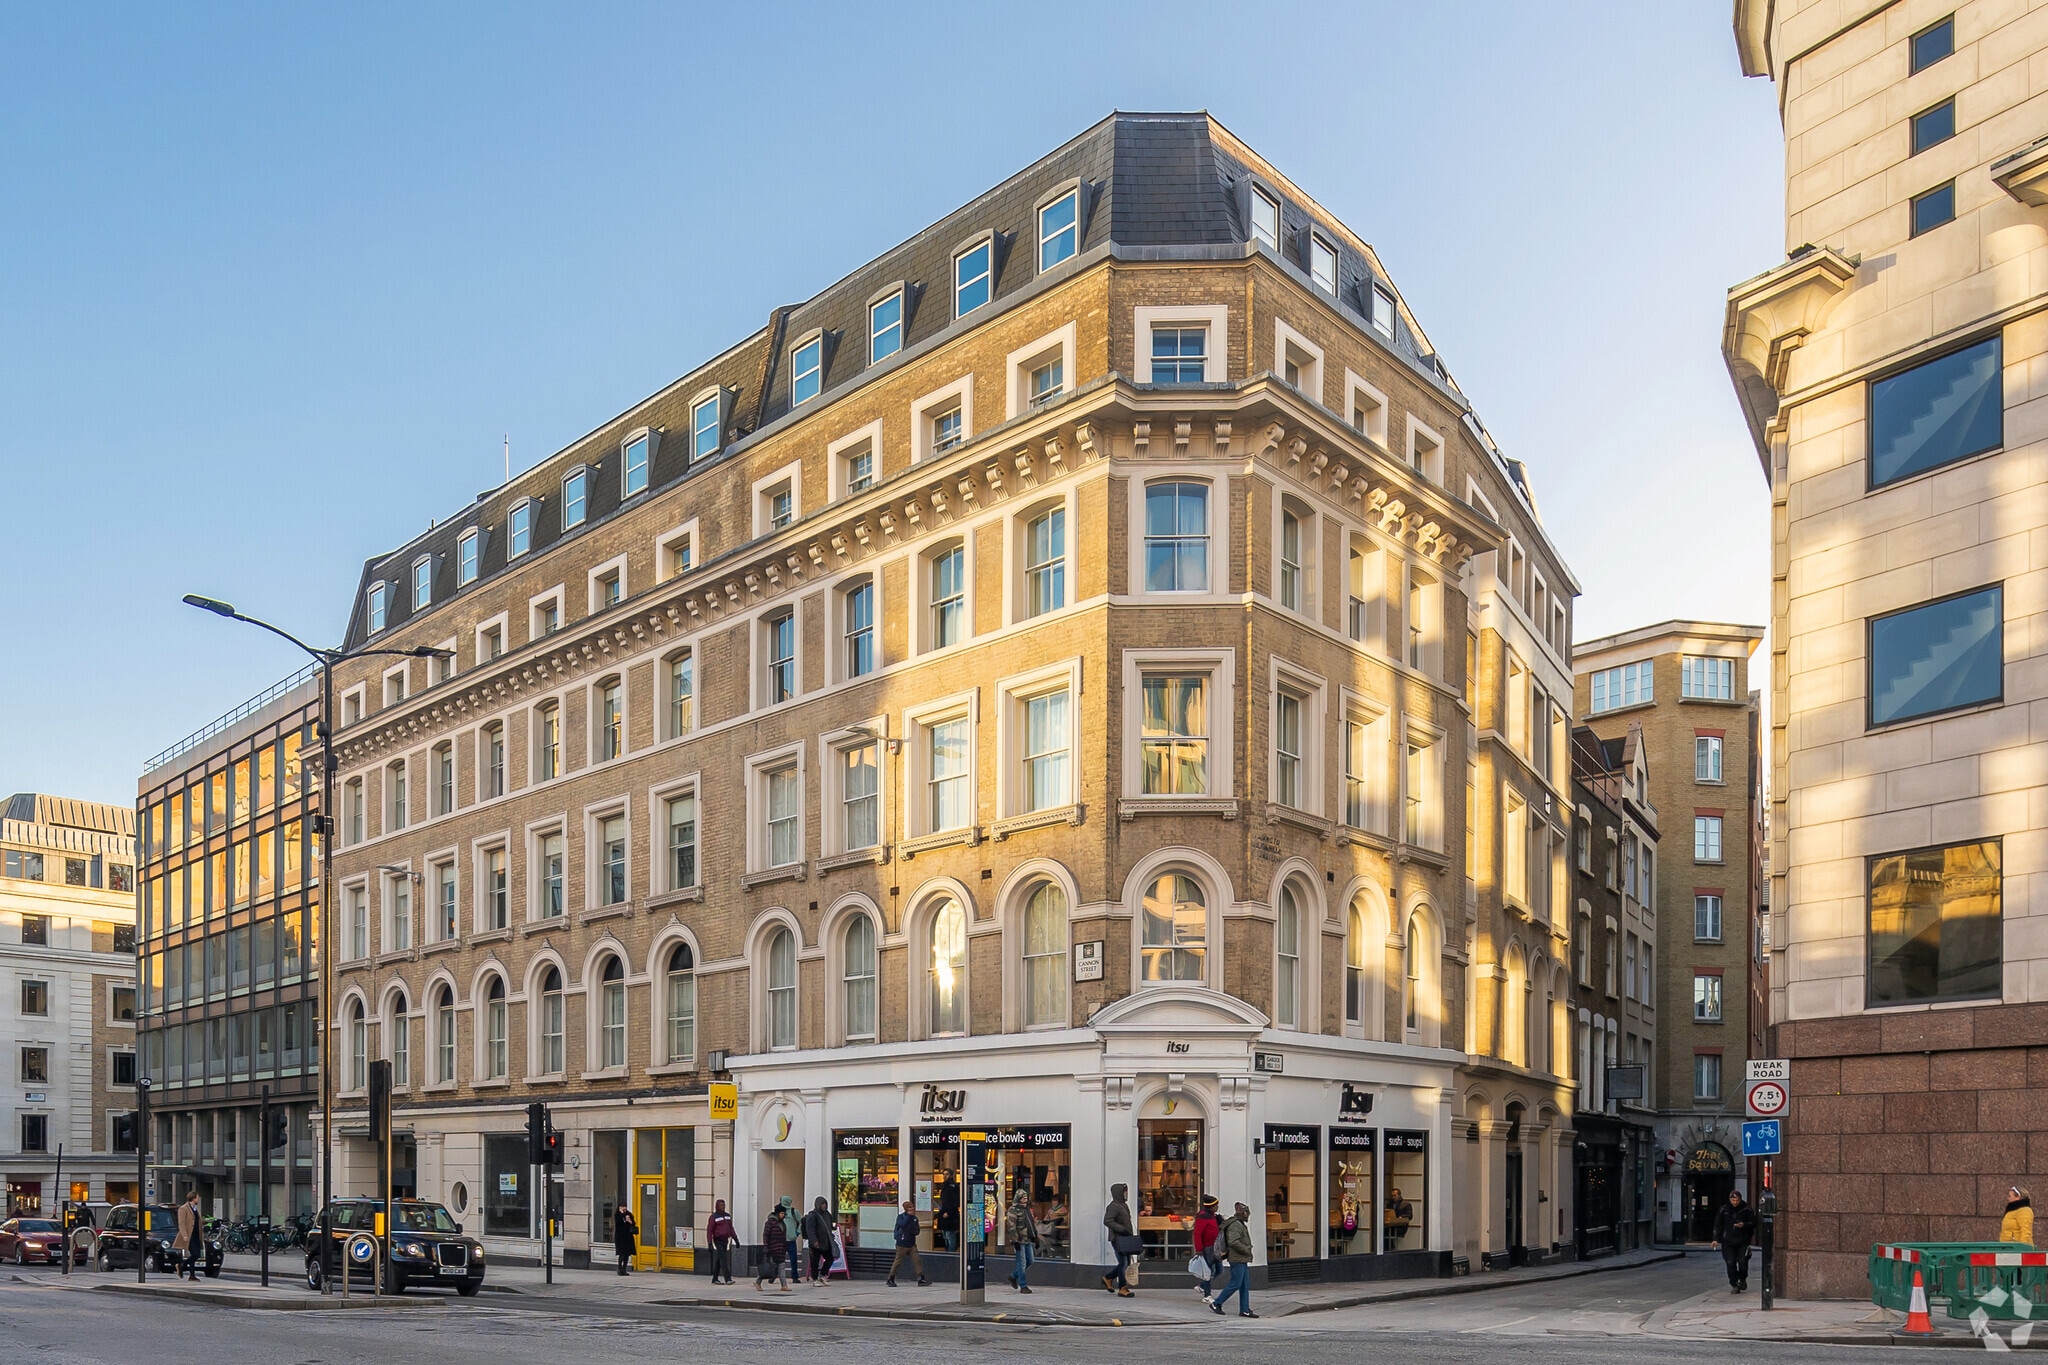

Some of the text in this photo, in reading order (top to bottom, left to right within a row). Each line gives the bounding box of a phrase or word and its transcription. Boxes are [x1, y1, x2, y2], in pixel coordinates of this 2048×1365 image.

[1166, 1040, 1190, 1053] itsu
[1753, 1070, 1783, 1078] ROAD
[713, 1095, 735, 1109] itsu
[920, 1083, 966, 1113] itsu
[1340, 1083, 1374, 1114] itsu
[843, 1133, 889, 1145] asian salads
[919, 1133, 940, 1144] sushi
[985, 1132, 998, 1143] ice
[999, 1131, 1025, 1143] bowls
[1035, 1133, 1063, 1145] gyoza
[1284, 1132, 1310, 1144] noodles
[1334, 1134, 1370, 1146] asian salads
[1388, 1136, 1423, 1148] sushi soups
[1689, 1160, 1729, 1171] Square
